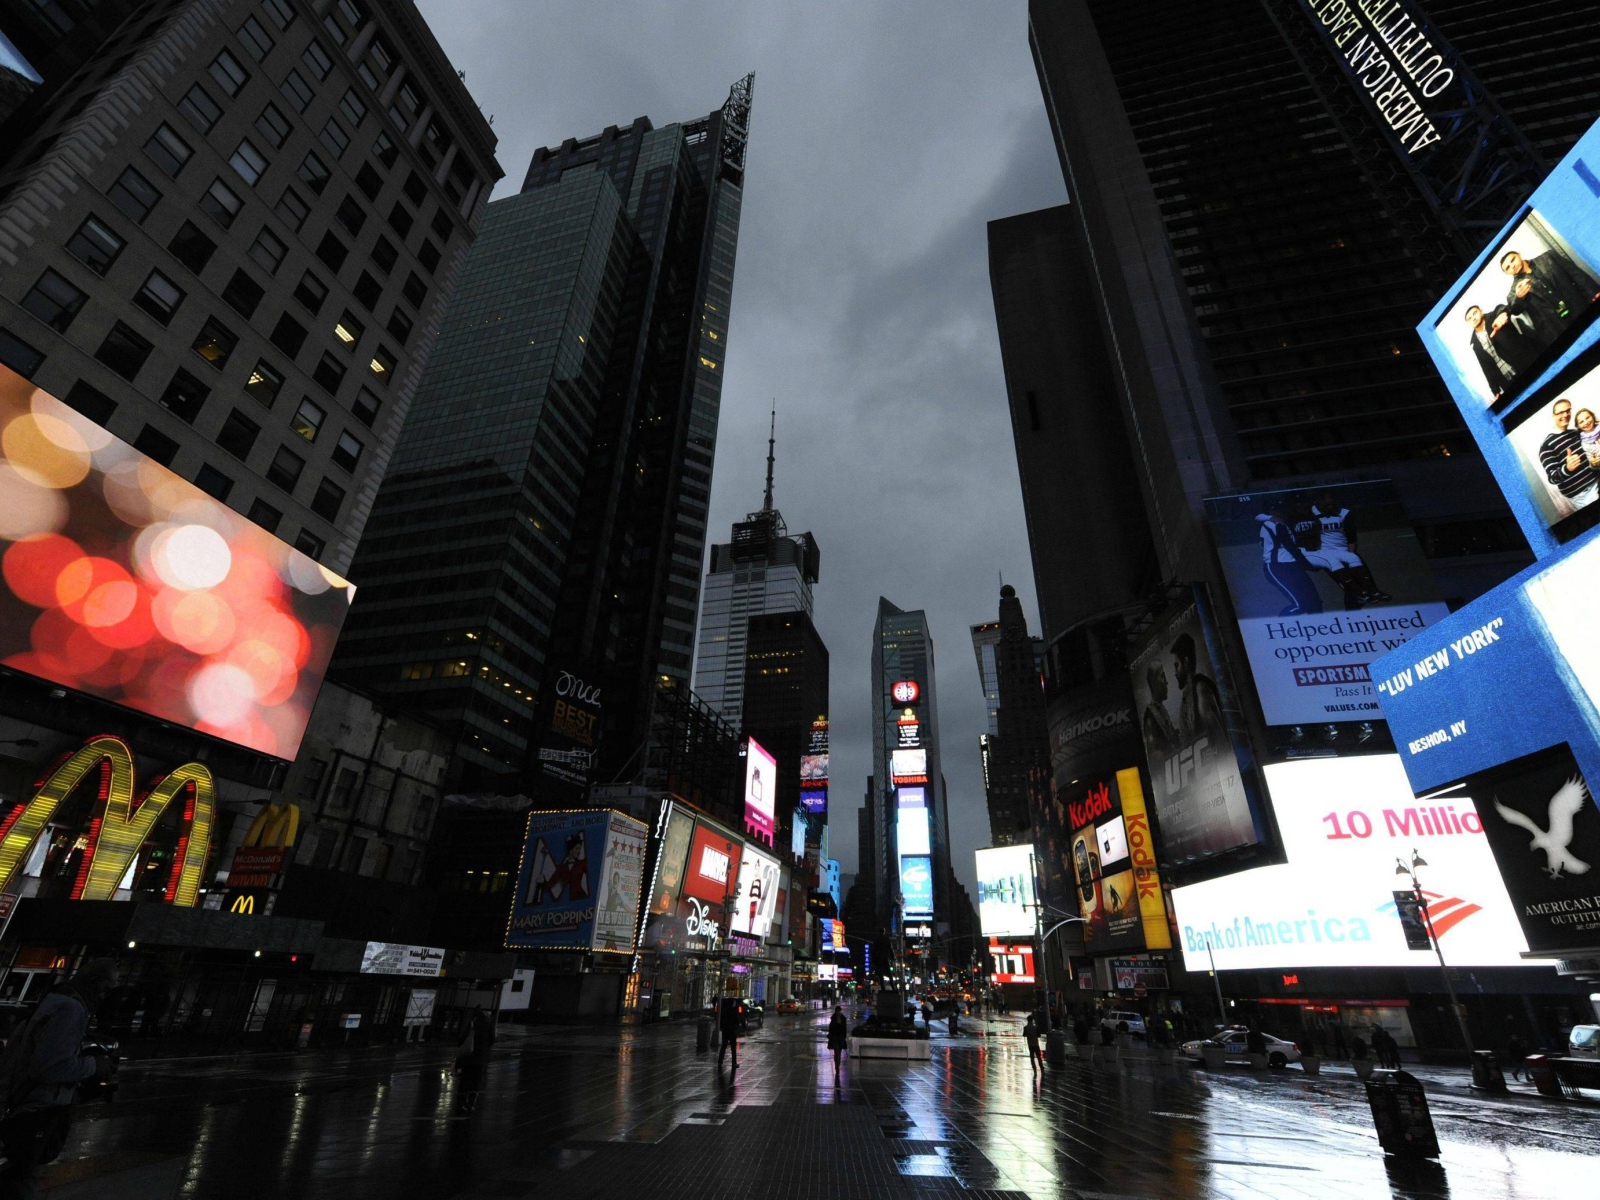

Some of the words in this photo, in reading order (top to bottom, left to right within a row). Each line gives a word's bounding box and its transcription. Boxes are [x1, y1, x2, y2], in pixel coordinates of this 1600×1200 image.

[1344, 33, 1441, 155] AMERICAN
[1265, 617, 1344, 642] Helped
[1345, 610, 1426, 636] injured
[1274, 638, 1377, 664] opponent
[1381, 632, 1412, 649] wi
[1377, 667, 1413, 697] “LUV
[1413, 647, 1451, 681] NEW
[1449, 616, 1504, 660] YORK”
[1297, 665, 1371, 684] SPORTSM
[1335, 686, 1359, 697] Pass
[1362, 685, 1373, 696] It
[555, 699, 597, 731] BEST
[1324, 702, 1380, 713] VALUES.COM
[1408, 728, 1452, 755] BESHOO,
[1449, 719, 1467, 738] NY
[893, 775, 928, 784] TOSHIBA
[1164, 737, 1209, 795] UFC
[1068, 781, 1113, 831] Kodak
[1322, 810, 1373, 840] 10
[1382, 805, 1485, 838] Millio
[234, 854, 282, 864] McDonald's
[1125, 812, 1159, 900] Kodak
[513, 911, 546, 930] MARY
[547, 907, 595, 926] POPPINS
[597, 910, 635, 926] NEWSIES
[1525, 897, 1594, 916] AMERICAN
[1114, 960, 1167, 968] MARQUIS
